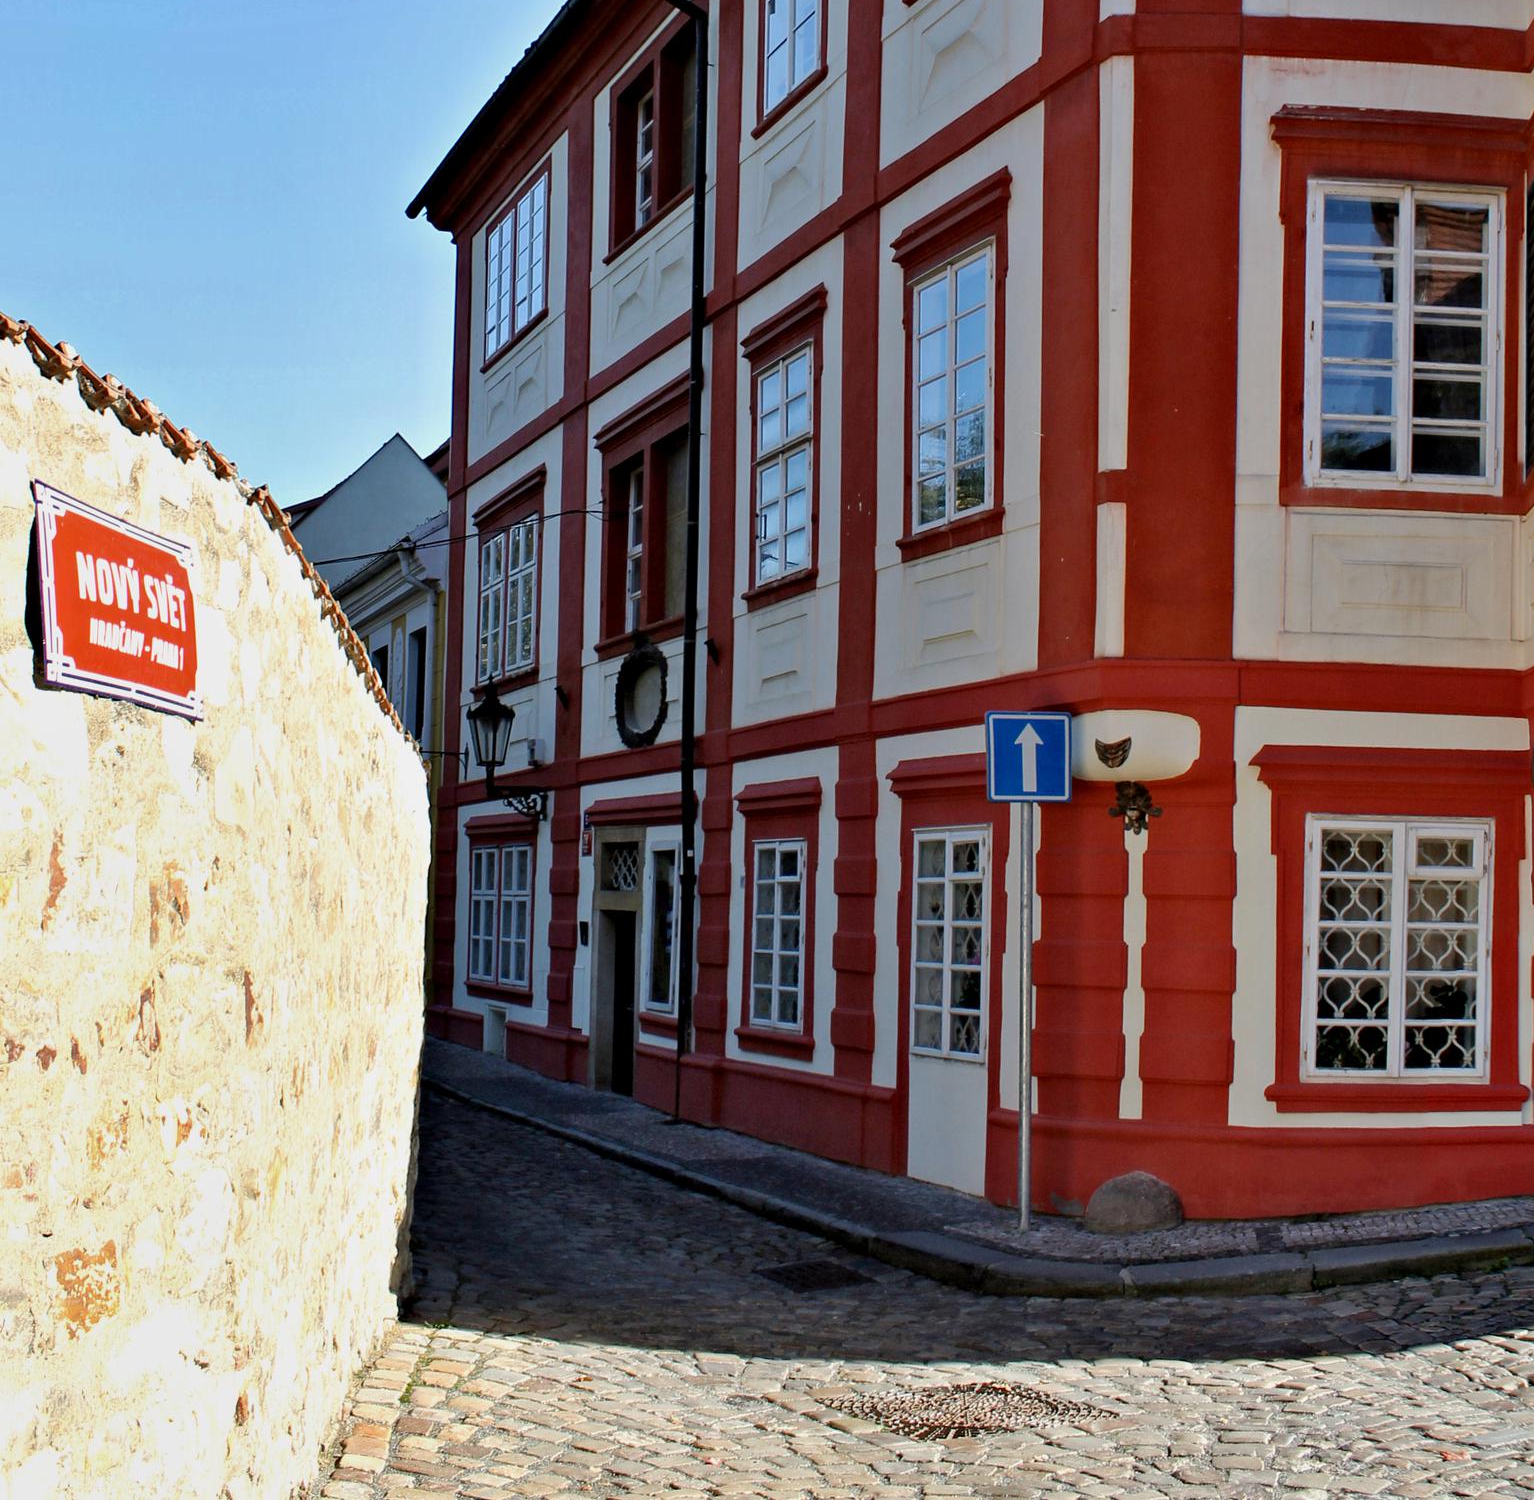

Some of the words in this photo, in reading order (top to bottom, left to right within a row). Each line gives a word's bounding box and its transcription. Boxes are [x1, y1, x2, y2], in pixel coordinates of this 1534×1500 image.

[75, 551, 140, 614] NOVÝ
[143, 573, 187, 632] SVĚT
[89, 617, 145, 658] HRADČANY
[179, 646, 184, 671] 1
